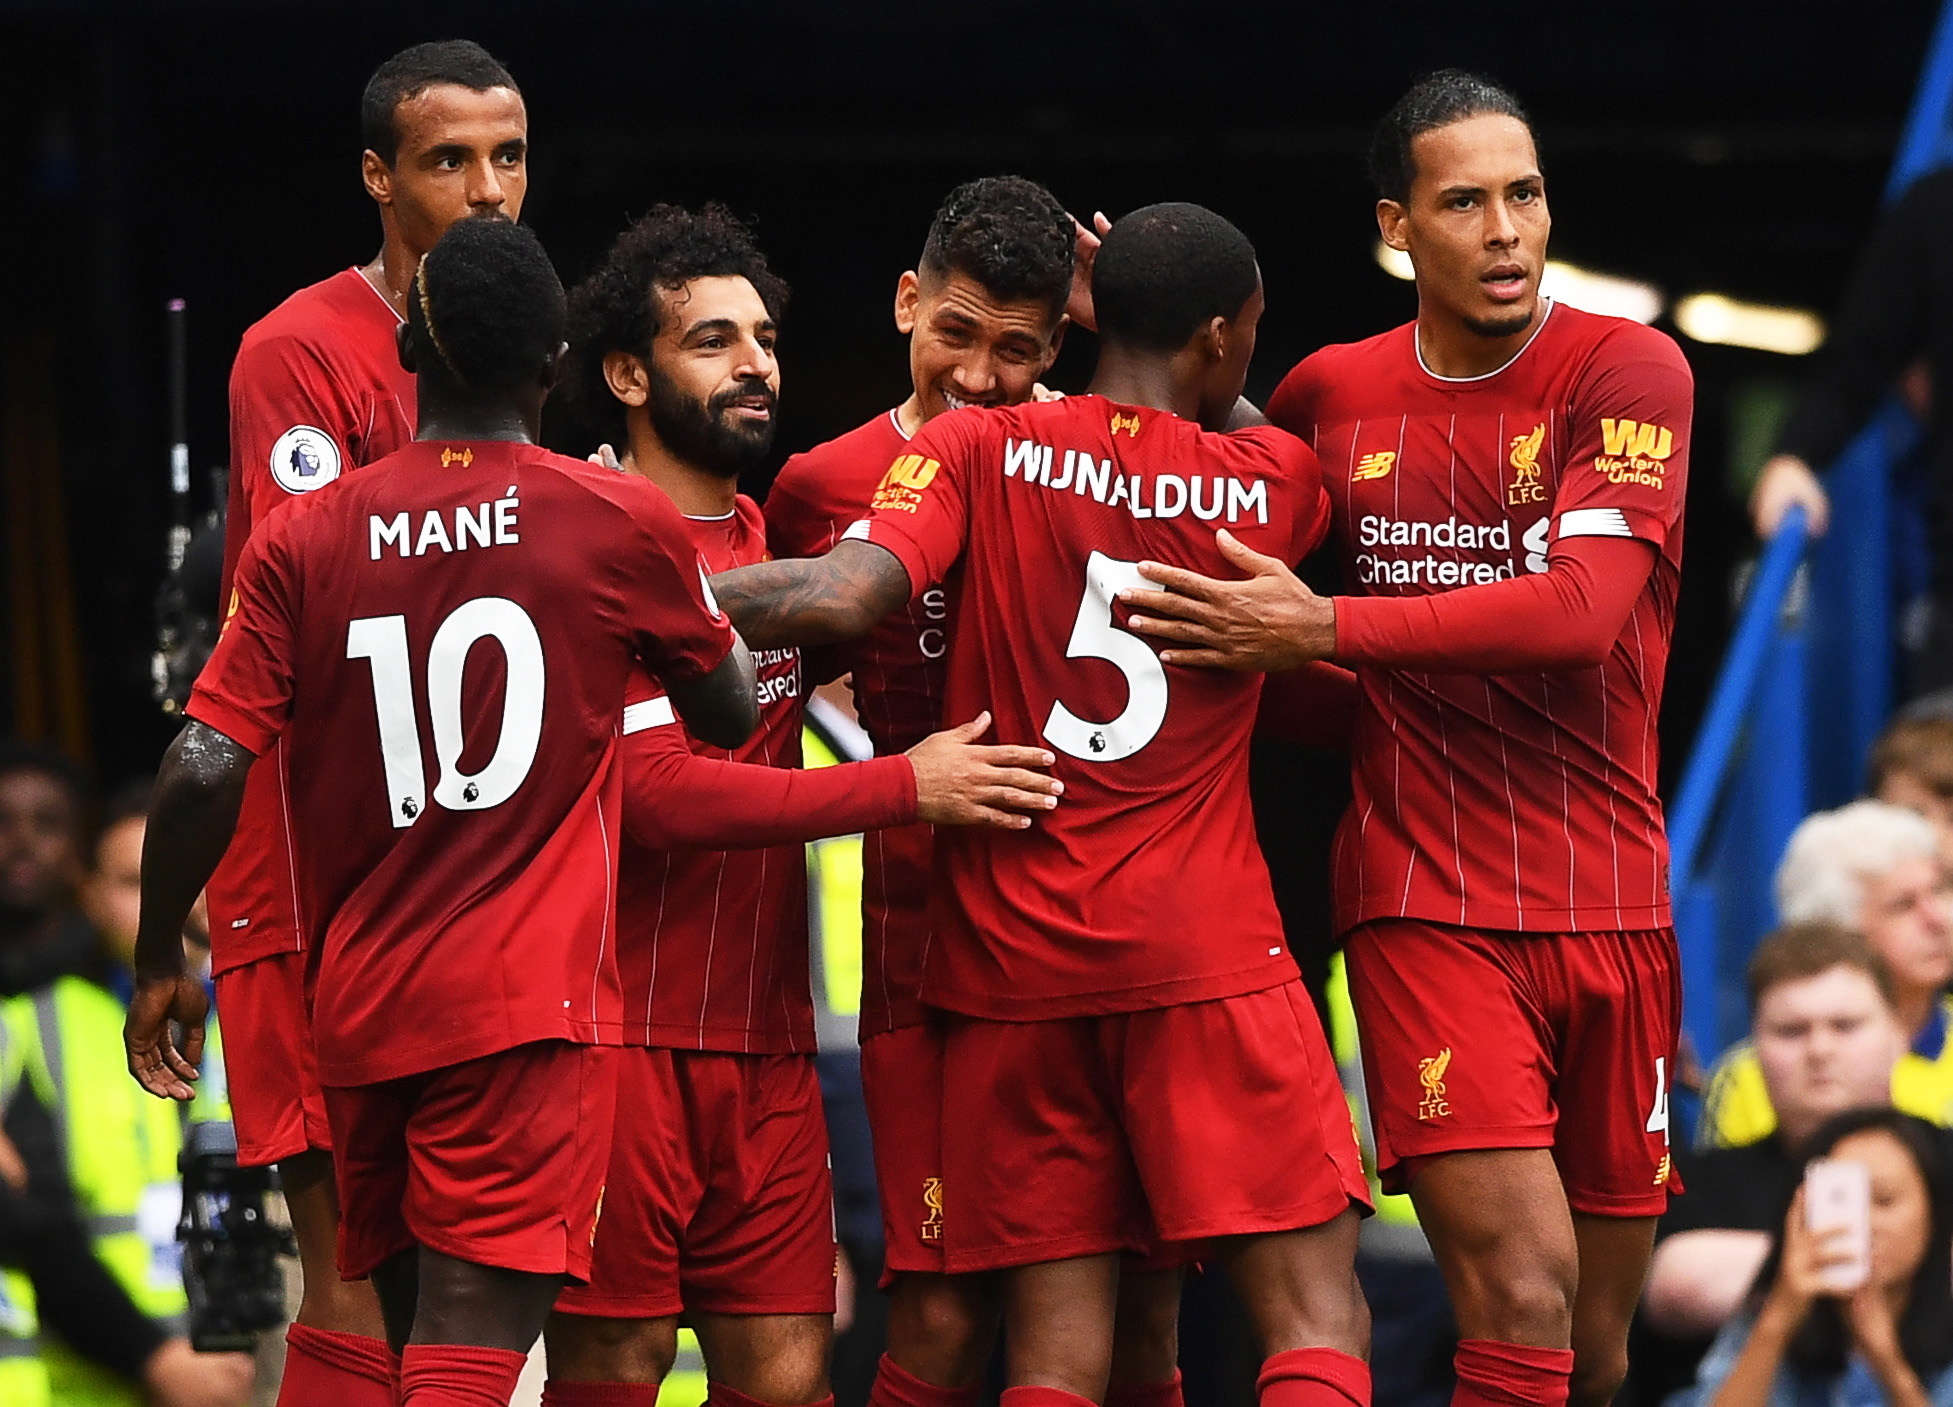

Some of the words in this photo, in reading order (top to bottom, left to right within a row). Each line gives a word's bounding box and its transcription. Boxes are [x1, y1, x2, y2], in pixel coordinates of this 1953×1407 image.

[1601, 418, 1673, 459] WU
[1004, 437, 1269, 524] WIJNALDUM
[1608, 468, 1662, 490] Union
[369, 485, 520, 560] MANÉ
[1359, 515, 1511, 551] Standard
[1356, 554, 1515, 585] Chartered
[1042, 550, 1168, 762] 5
[346, 597, 546, 828] 10
[1646, 1056, 1670, 1147] 4
